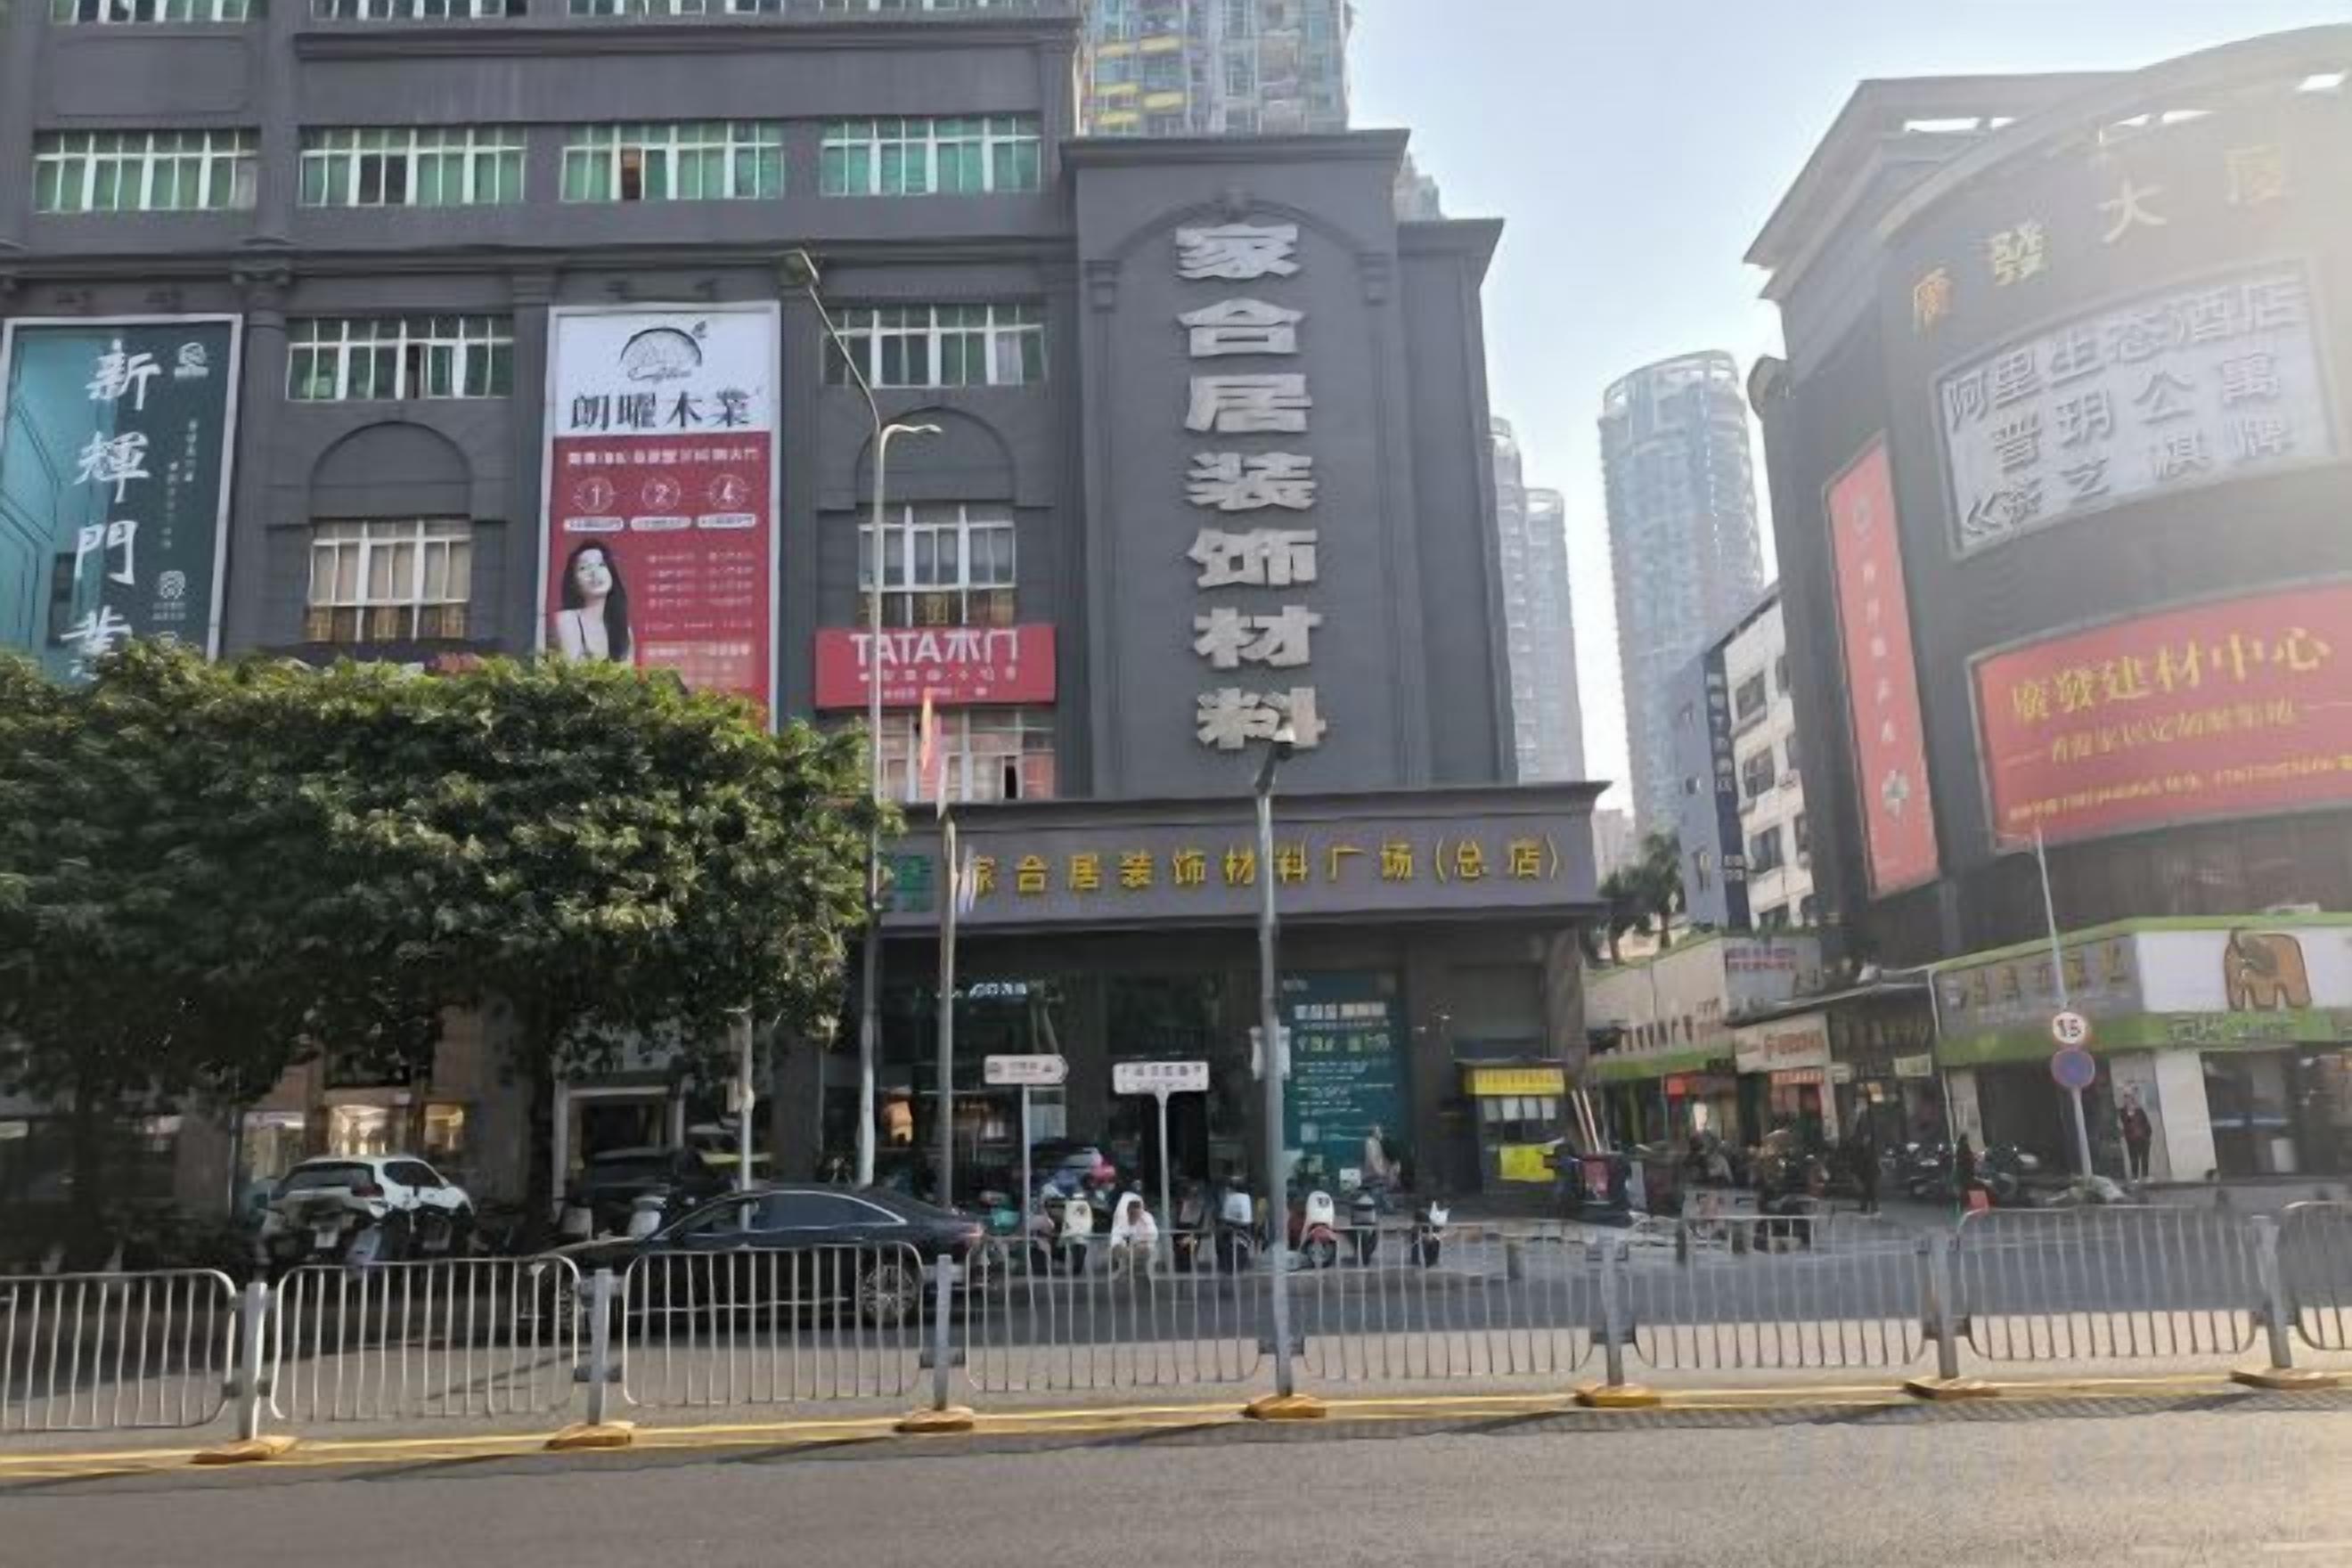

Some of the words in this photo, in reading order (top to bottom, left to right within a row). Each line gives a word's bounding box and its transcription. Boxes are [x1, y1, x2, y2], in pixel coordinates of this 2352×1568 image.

[1175, 223, 1327, 749] 家合居装饰材料
[849, 627, 1017, 666] TATA木门
